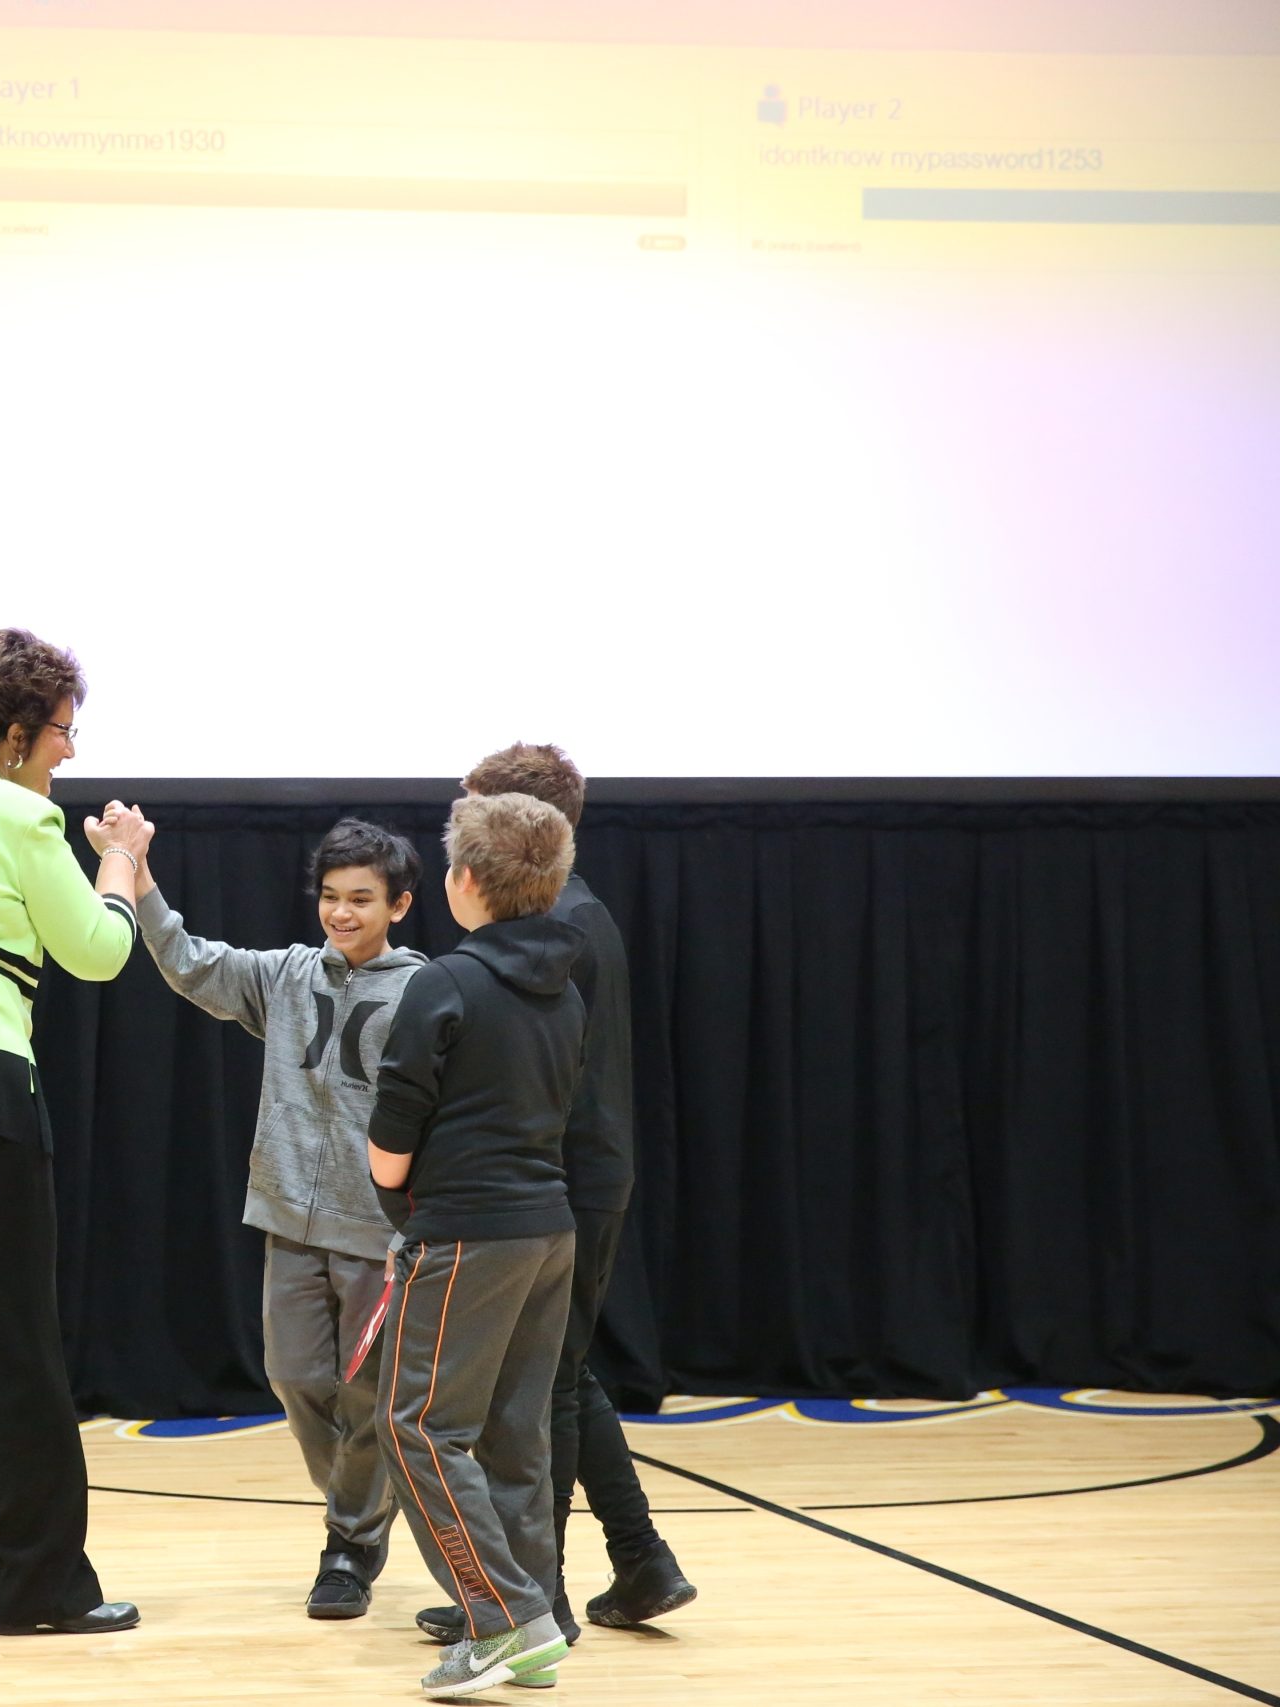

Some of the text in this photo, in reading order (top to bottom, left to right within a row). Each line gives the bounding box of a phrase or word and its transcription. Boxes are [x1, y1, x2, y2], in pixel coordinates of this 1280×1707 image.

[70, 77, 81, 99] 1
[798, 96, 904, 126] Player 2
